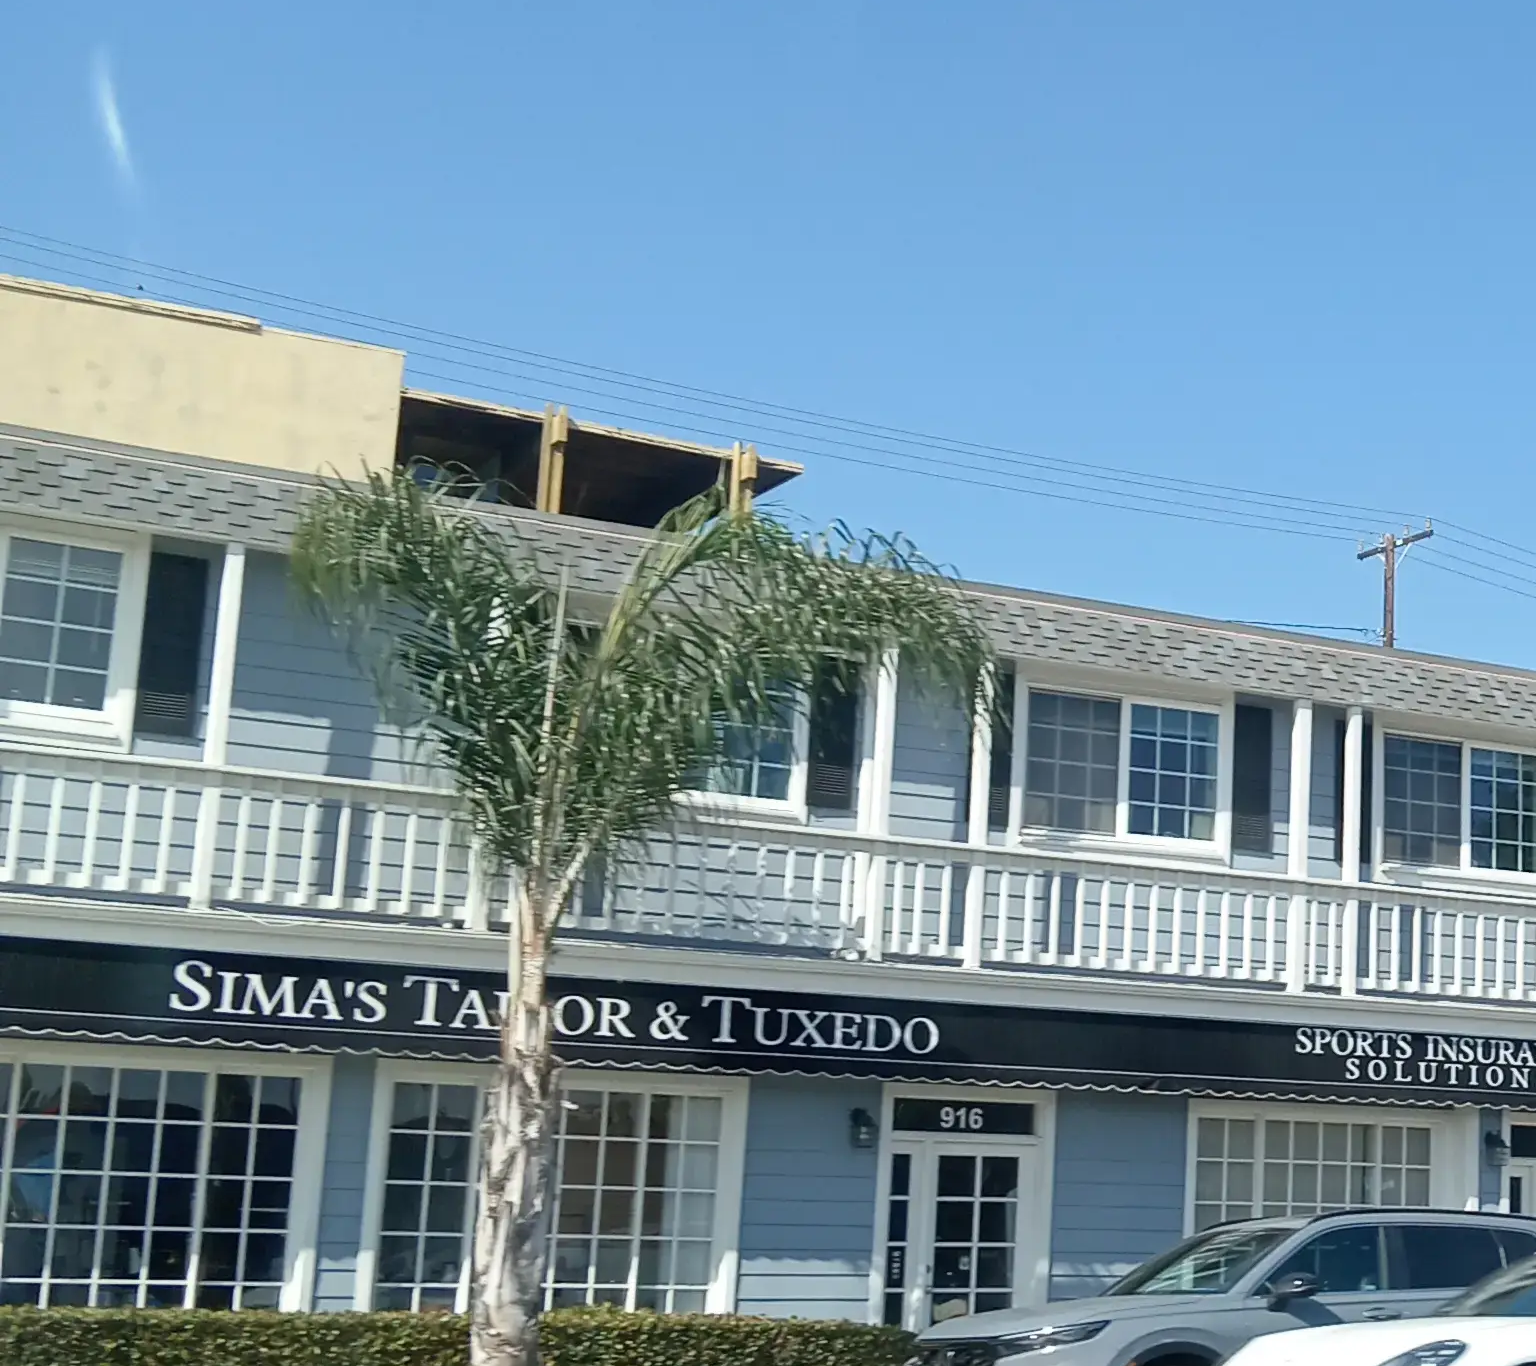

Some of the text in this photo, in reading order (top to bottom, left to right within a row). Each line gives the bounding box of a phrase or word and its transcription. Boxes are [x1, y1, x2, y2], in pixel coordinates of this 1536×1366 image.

[168, 959, 940, 1055] SIMA'S TAIOR & TUXEDO
[1294, 1027, 1413, 1059] SPORTS
[939, 1106, 984, 1130] 916
